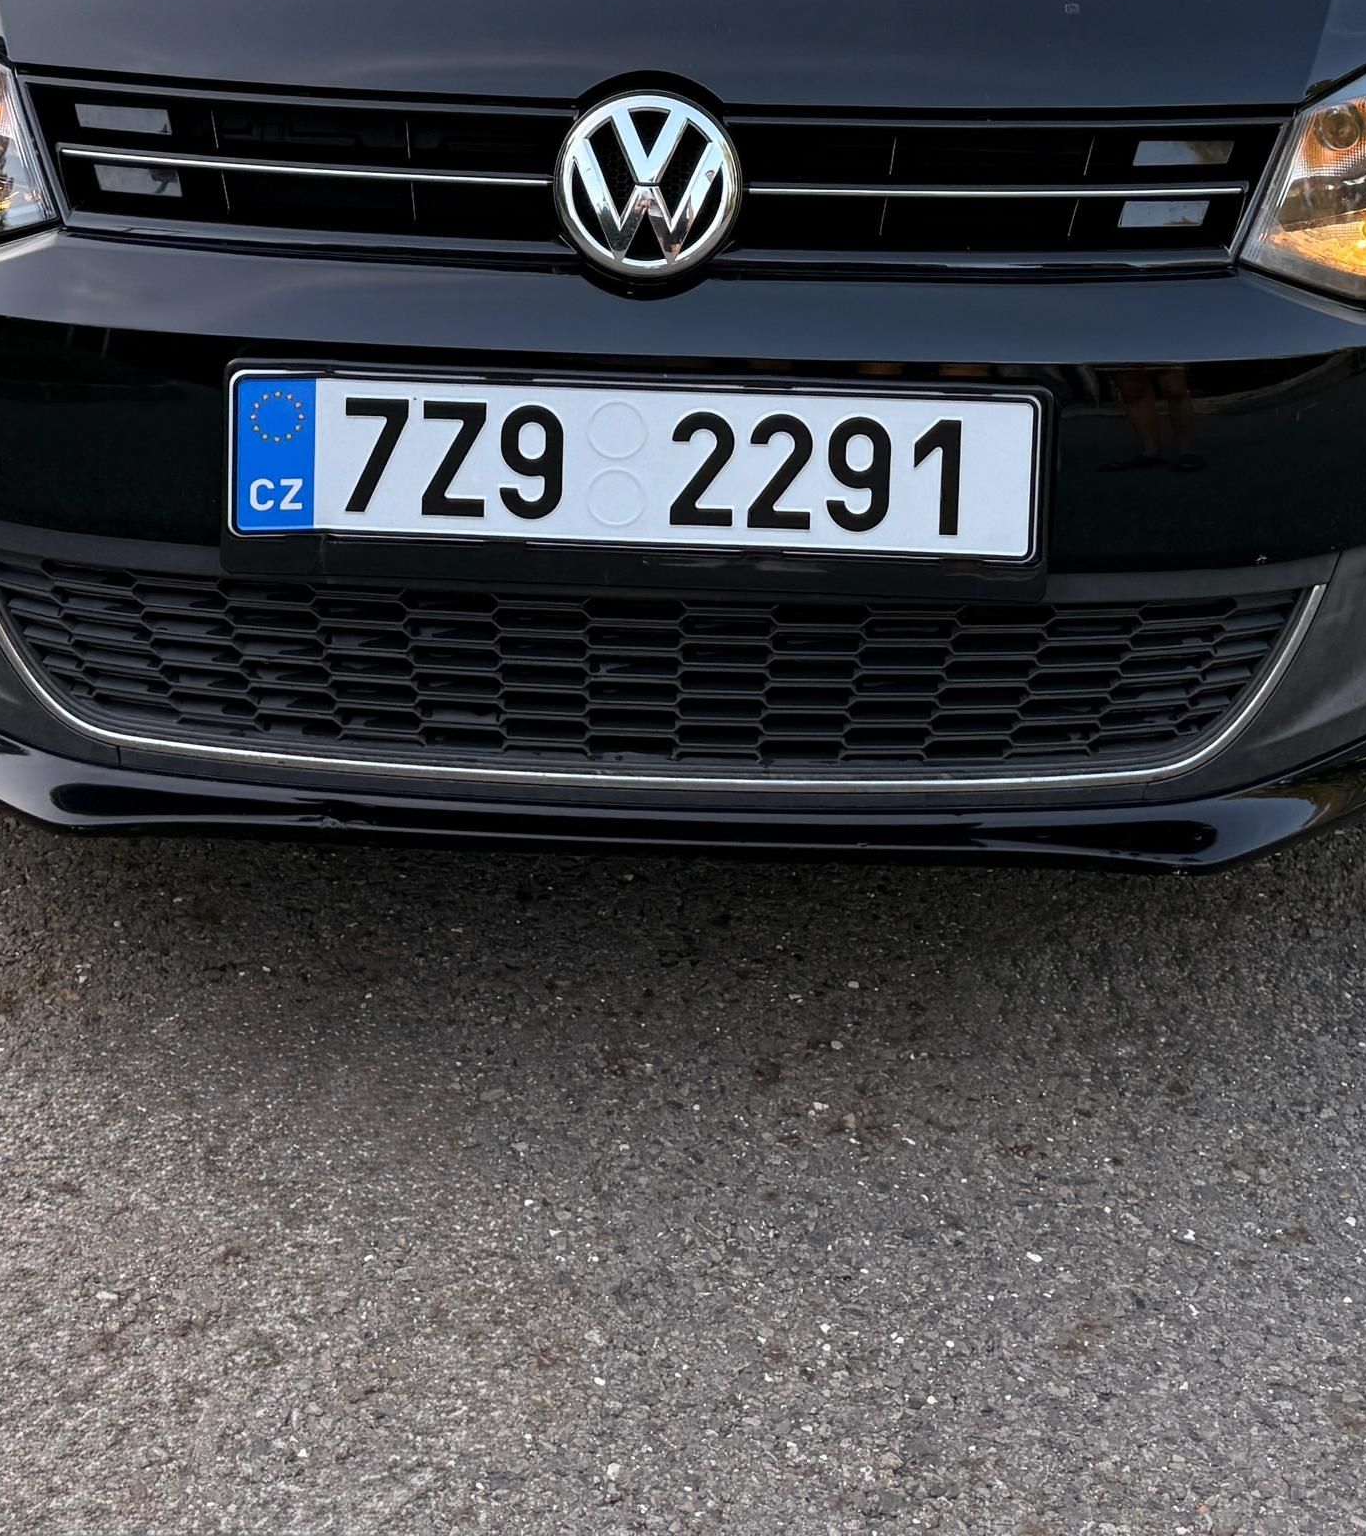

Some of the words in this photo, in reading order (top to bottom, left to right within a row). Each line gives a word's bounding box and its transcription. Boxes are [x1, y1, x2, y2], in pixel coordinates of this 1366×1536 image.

[567, 101, 729, 267] VW
[249, 478, 303, 511] CZ
[344, 396, 564, 520] 7Z9
[669, 410, 963, 536] 2291
